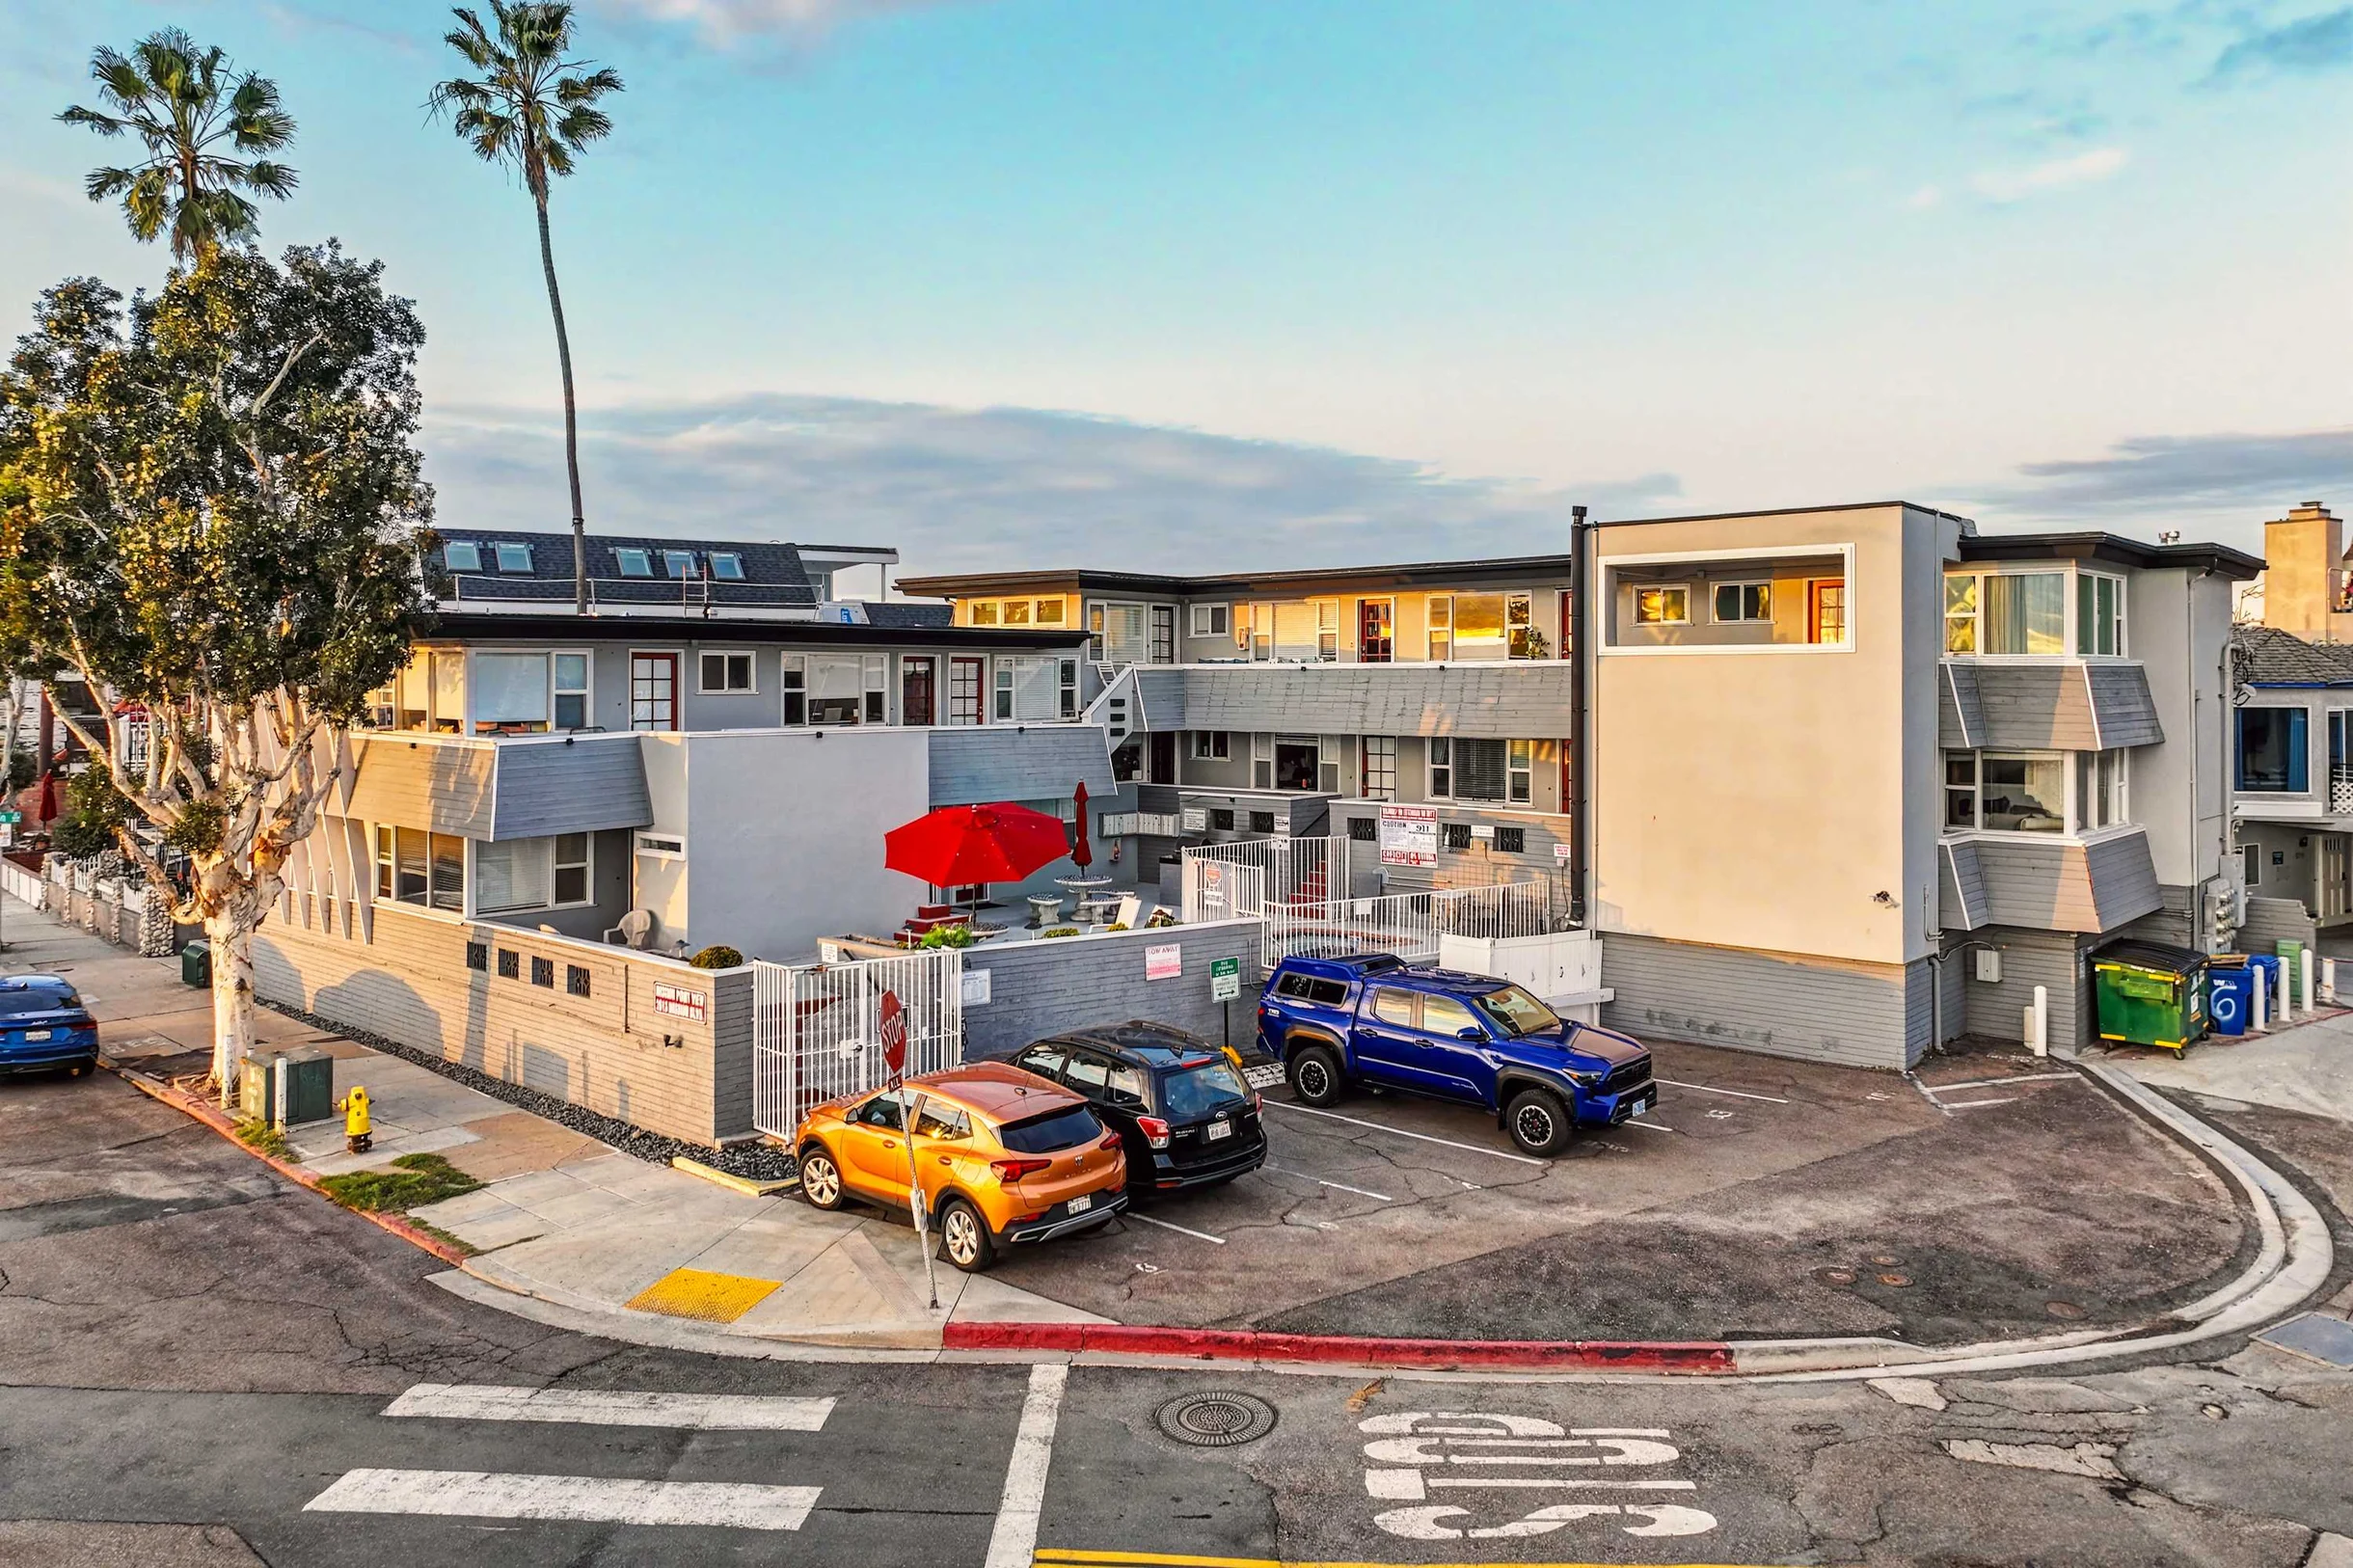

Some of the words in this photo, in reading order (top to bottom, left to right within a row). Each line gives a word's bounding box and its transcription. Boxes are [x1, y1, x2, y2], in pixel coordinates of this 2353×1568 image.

[2210, 985, 2237, 1021] 6
[881, 1010, 904, 1054] STOP
[889, 1076, 902, 1091] ALL
[1359, 1411, 1718, 1540] STOP
